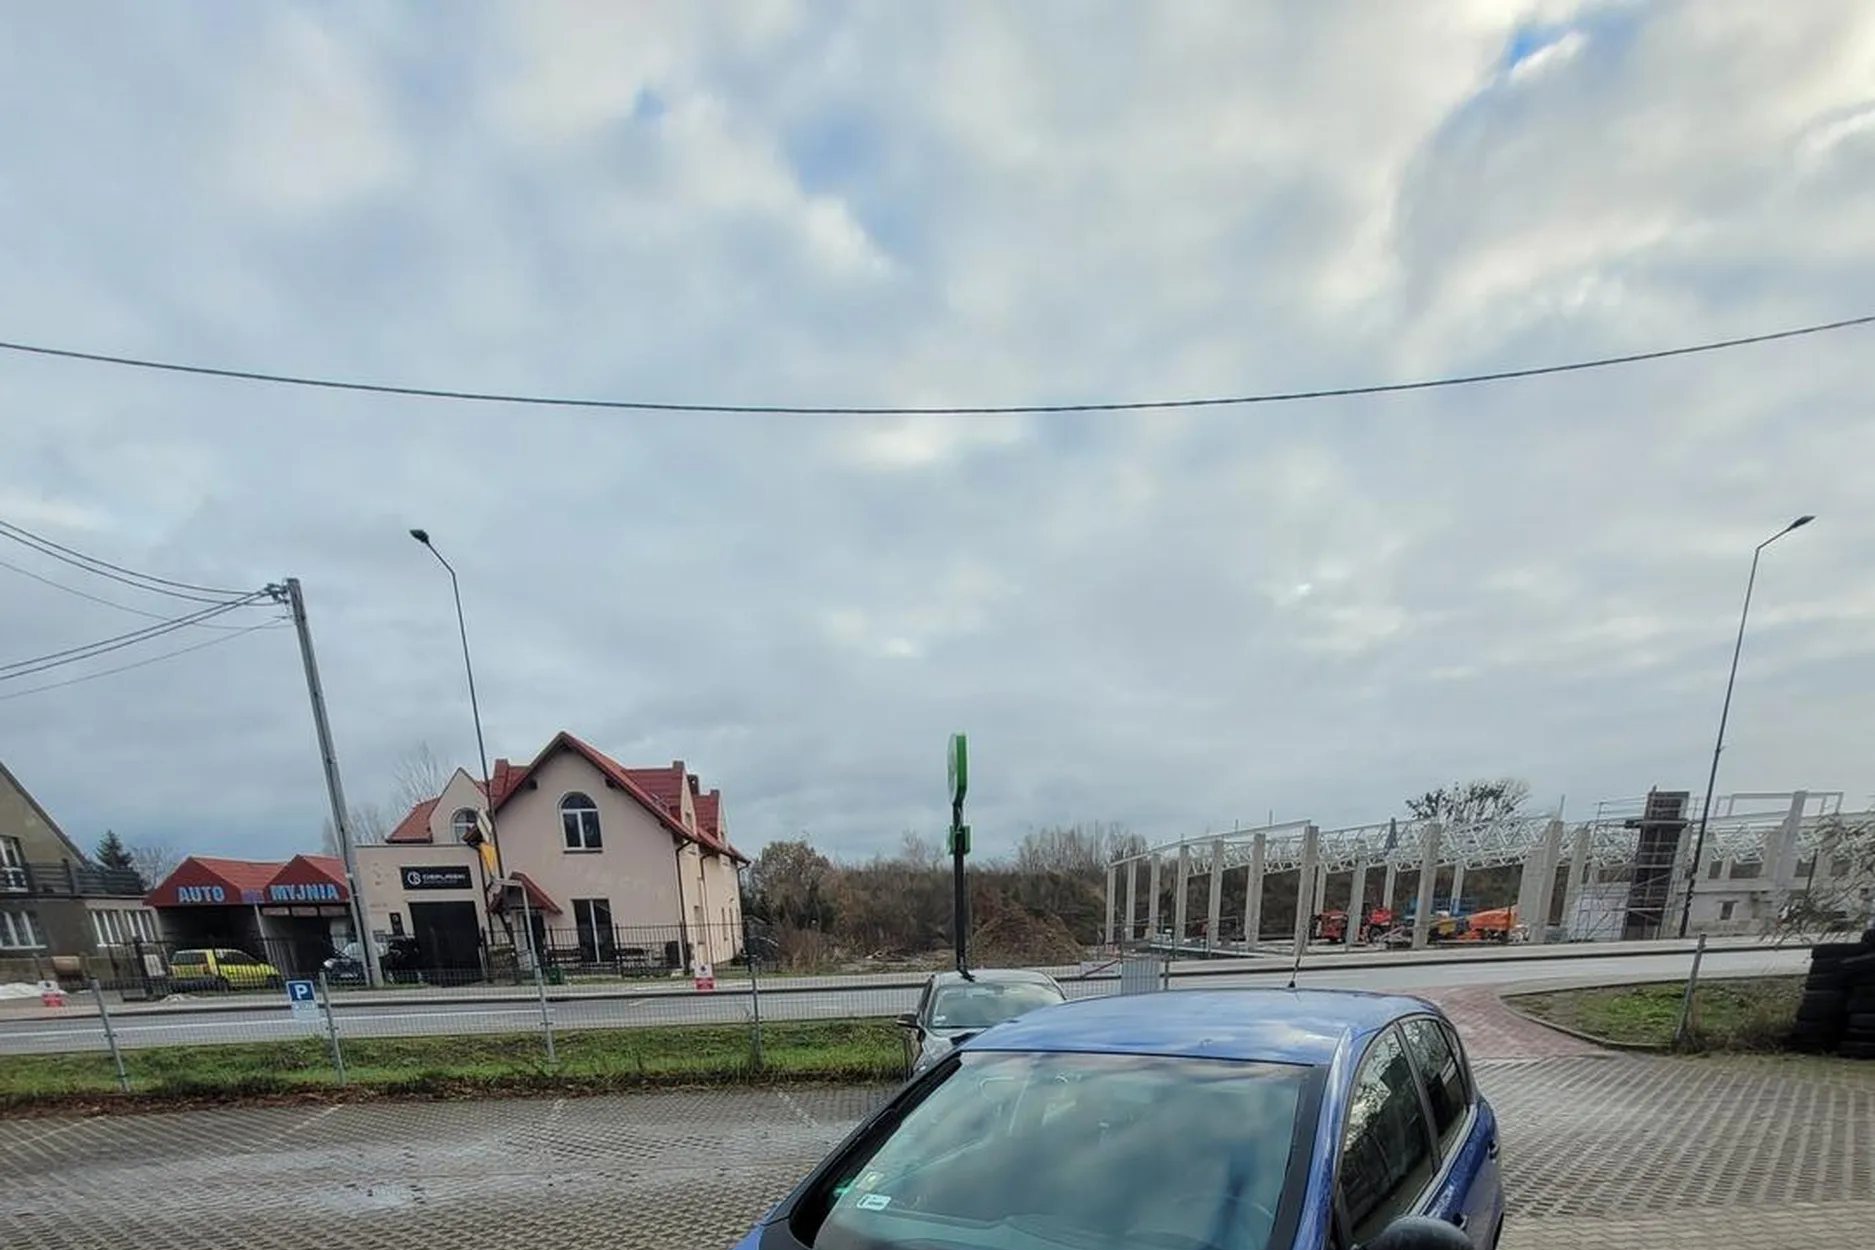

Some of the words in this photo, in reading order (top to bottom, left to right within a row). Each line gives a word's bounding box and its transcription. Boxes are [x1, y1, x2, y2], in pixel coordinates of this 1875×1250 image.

[178, 886, 225, 903] AUTO
[270, 883, 339, 900] MYJNIA
[294, 984, 308, 999] P
